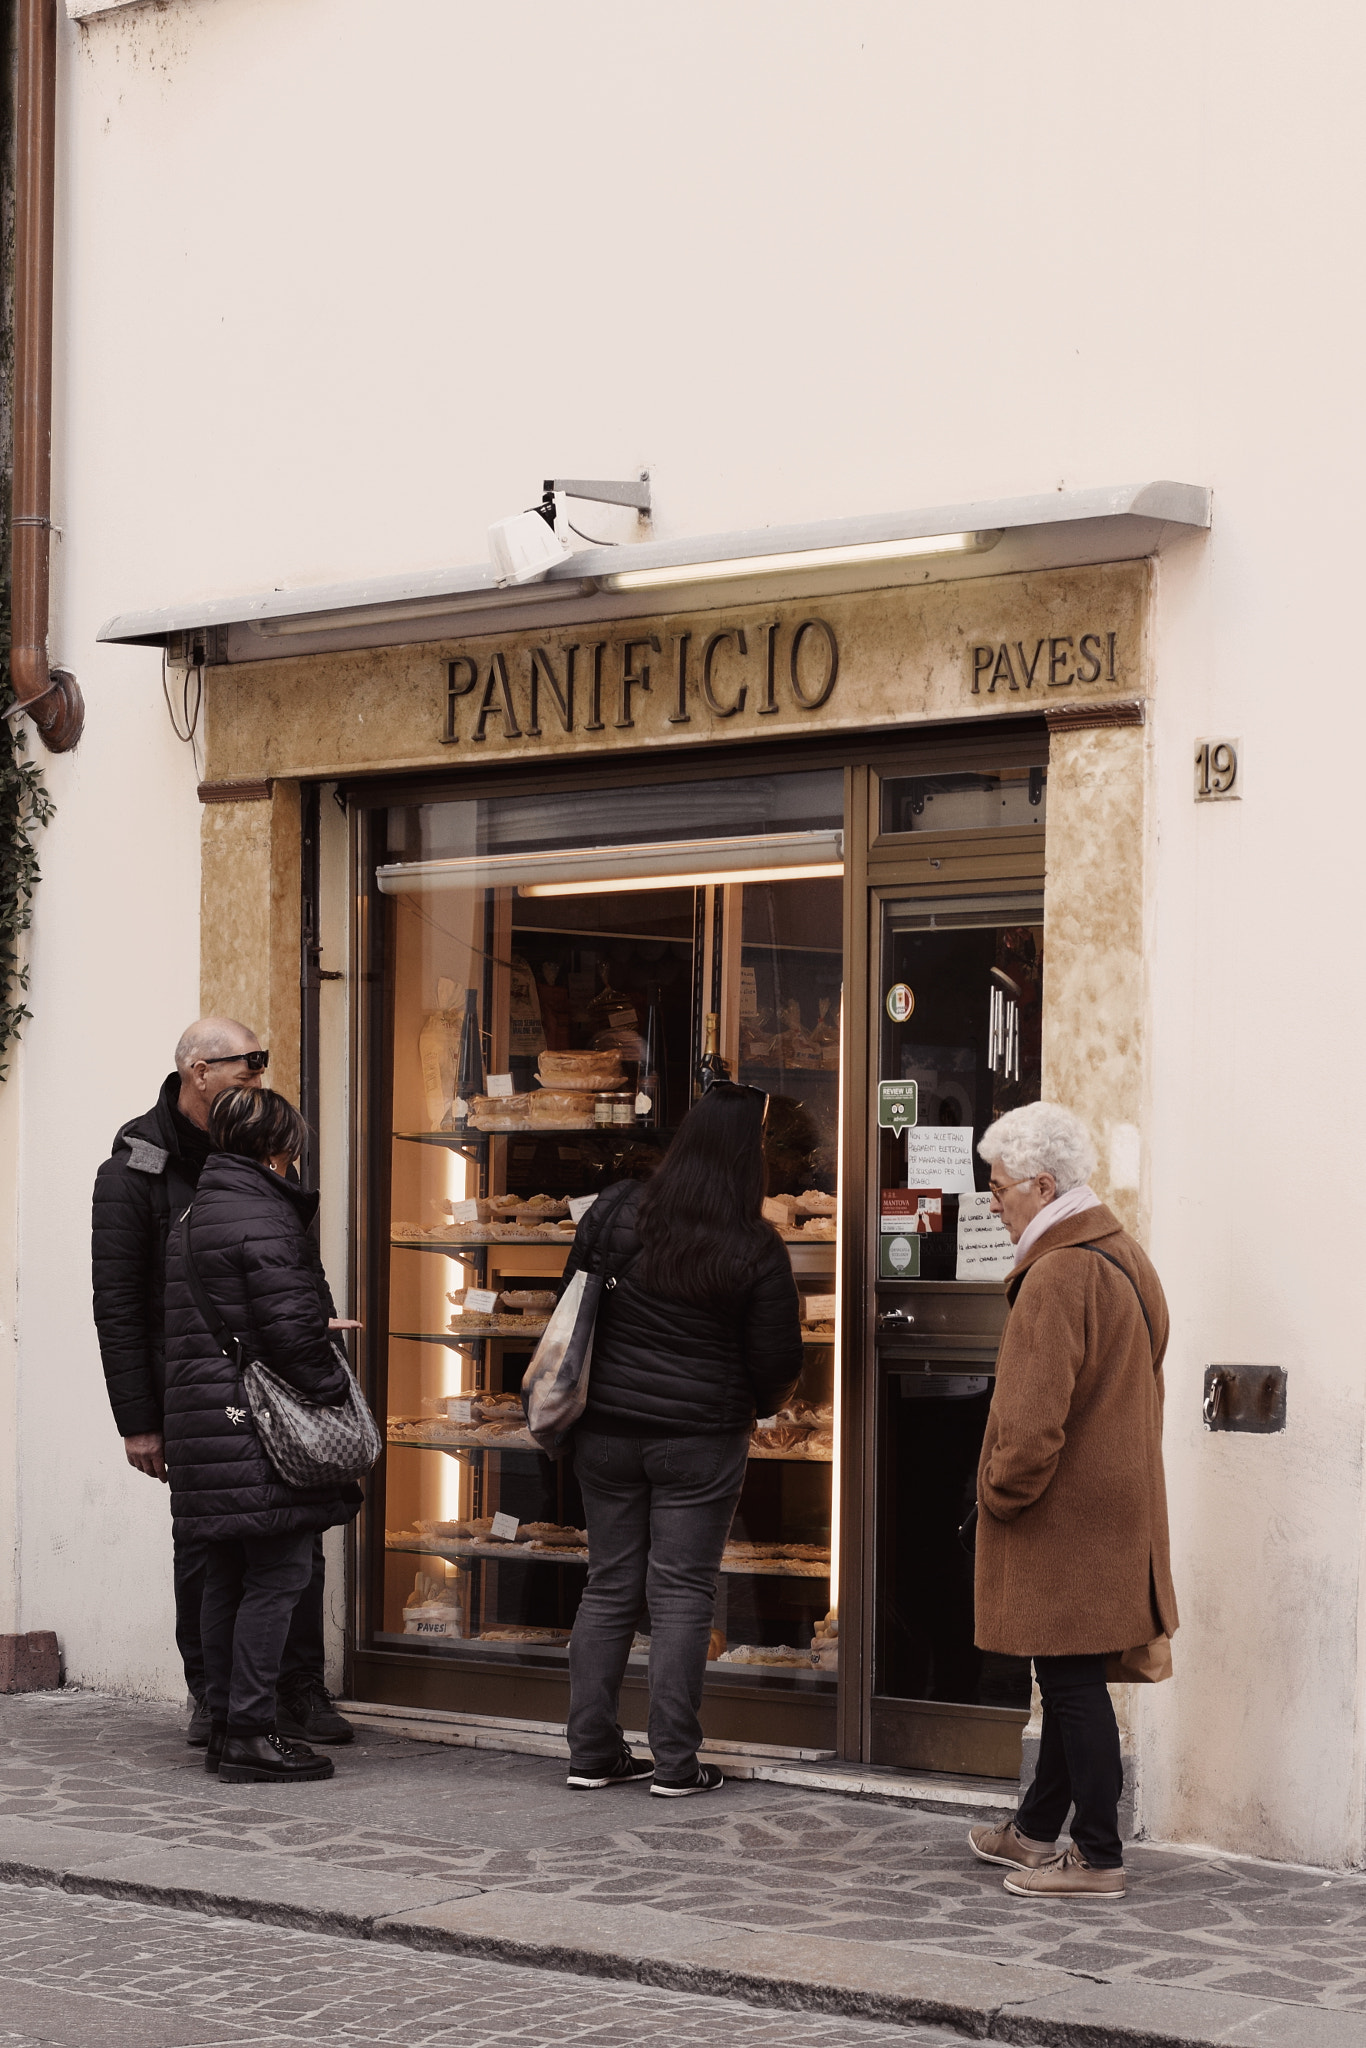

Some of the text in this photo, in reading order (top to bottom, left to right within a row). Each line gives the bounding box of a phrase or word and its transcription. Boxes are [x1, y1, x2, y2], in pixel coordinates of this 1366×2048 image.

[971, 631, 1116, 694] PAVESI
[439, 617, 839, 744] PANIFICIO
[1195, 743, 1238, 795] 19
[933, 1132, 964, 1142] ACCETTANO
[944, 1168, 955, 1176] PER
[957, 1169, 966, 1177] IL
[975, 1197, 992, 1206] ORA
[416, 1622, 447, 1633] PAVESI
